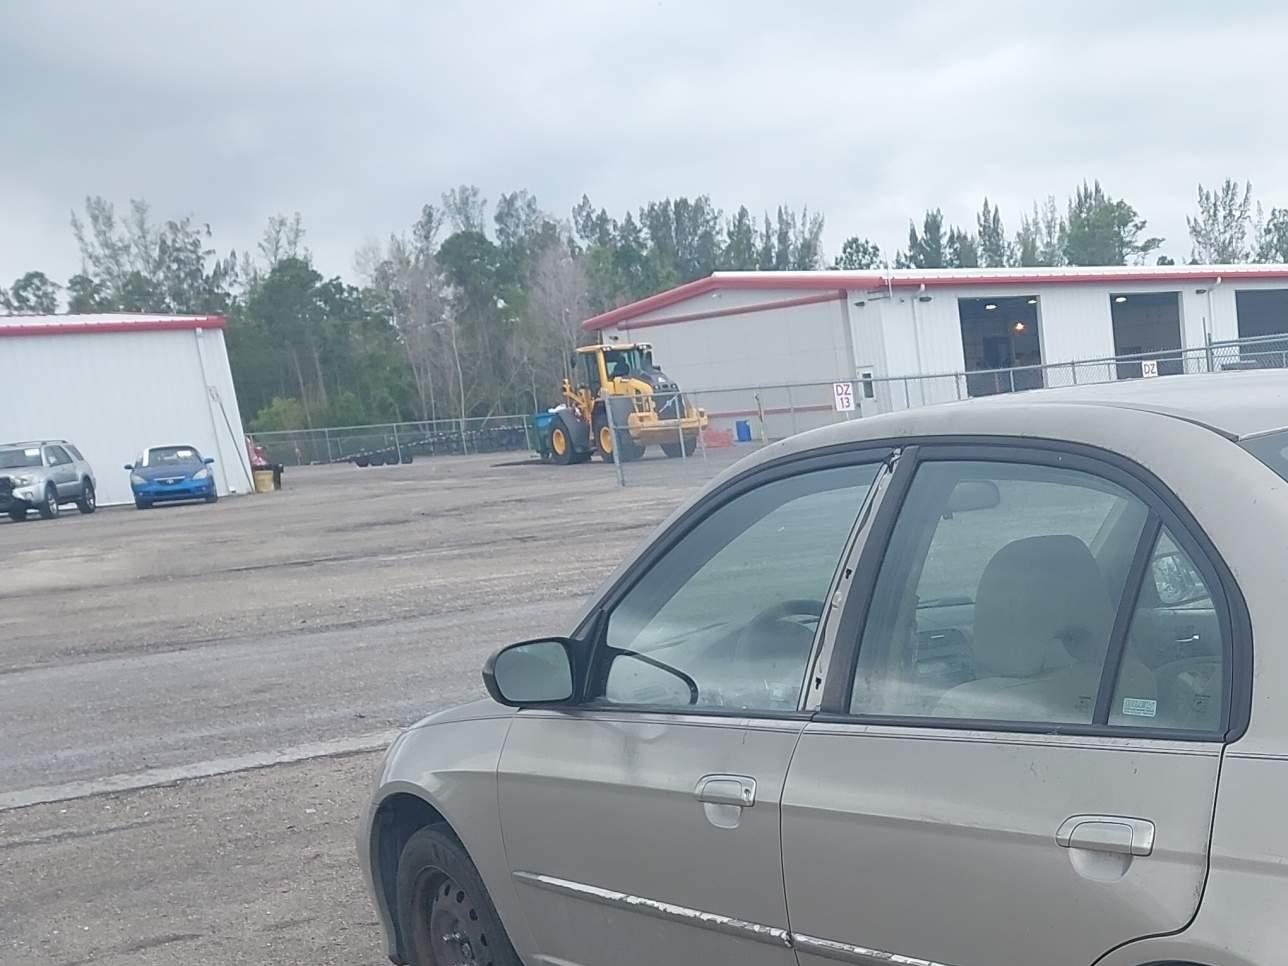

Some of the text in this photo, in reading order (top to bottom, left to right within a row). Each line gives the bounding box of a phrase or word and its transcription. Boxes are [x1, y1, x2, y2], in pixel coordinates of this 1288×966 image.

[1144, 363, 1156, 374] DZ
[836, 384, 851, 396] DZ
[840, 397, 850, 409] 13
